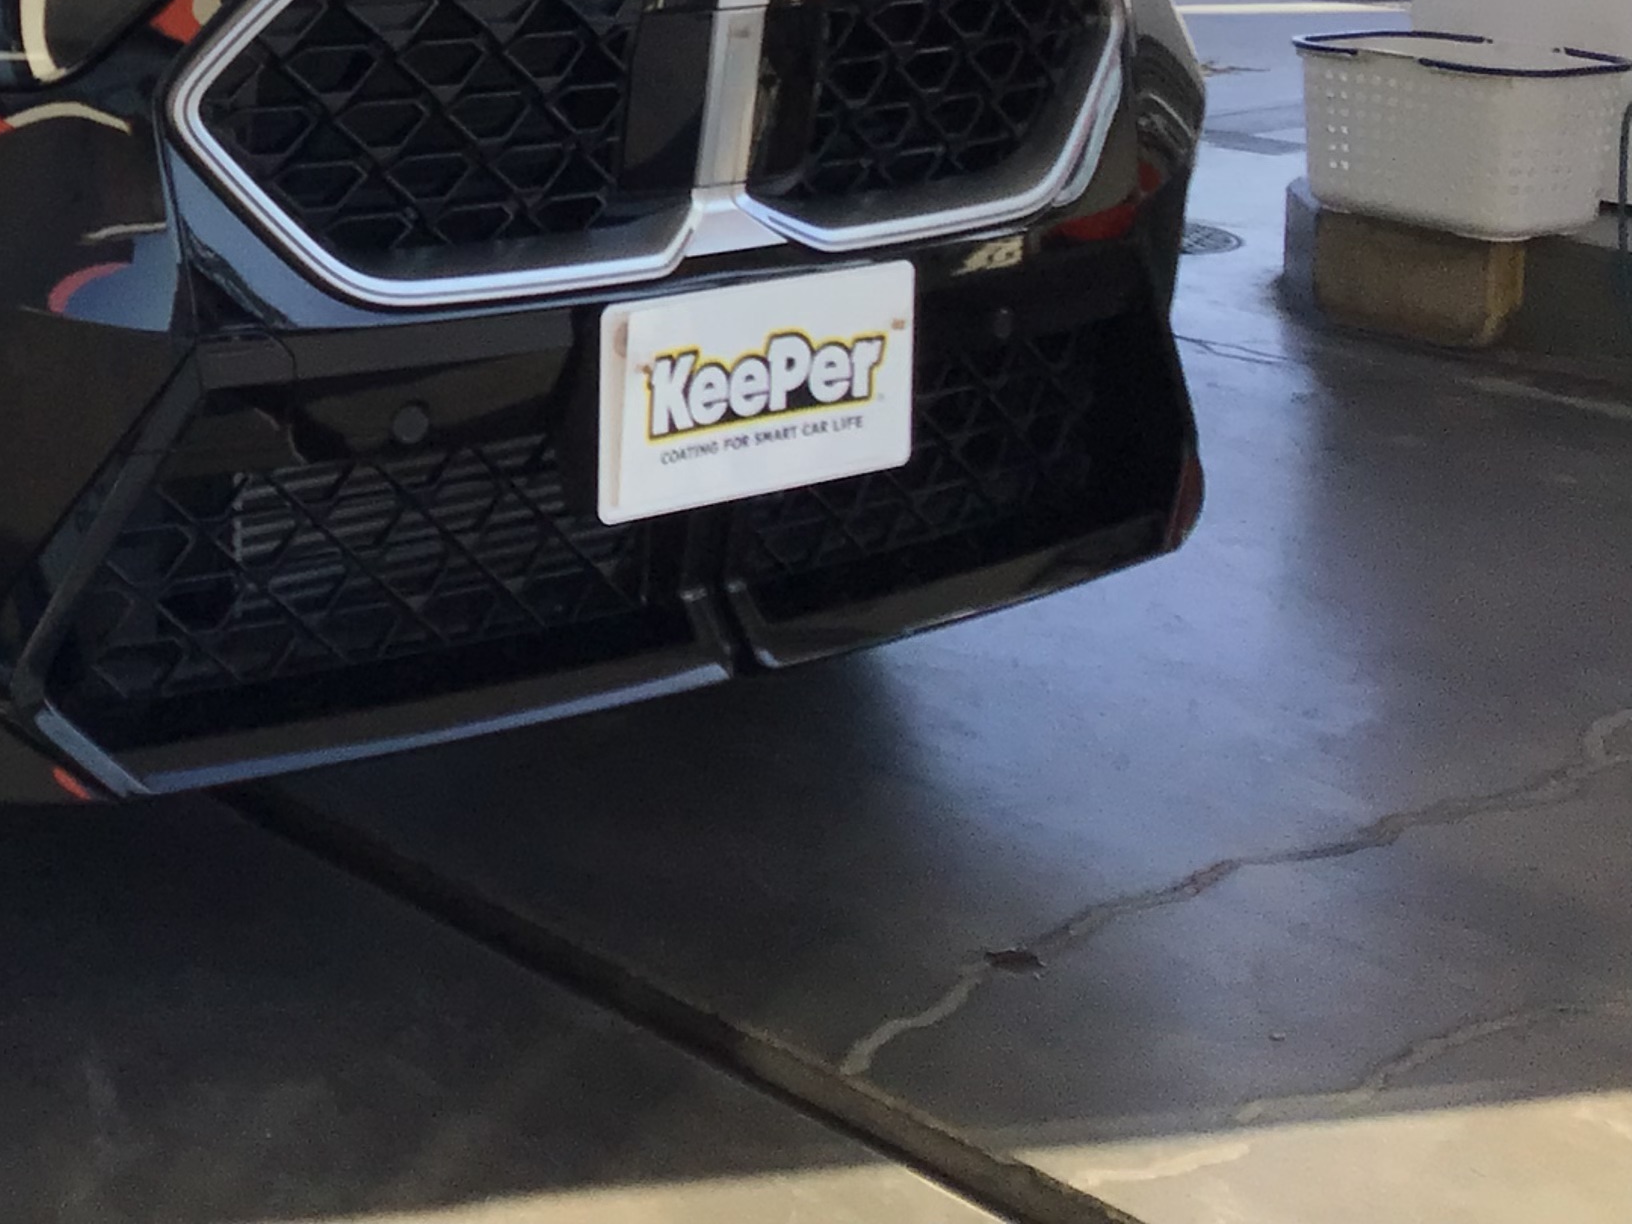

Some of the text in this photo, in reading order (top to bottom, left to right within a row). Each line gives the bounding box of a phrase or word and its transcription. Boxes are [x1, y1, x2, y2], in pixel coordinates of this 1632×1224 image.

[648, 332, 886, 441] KeePer
[661, 416, 864, 466] COATING FOR SMART CAR LIFE
